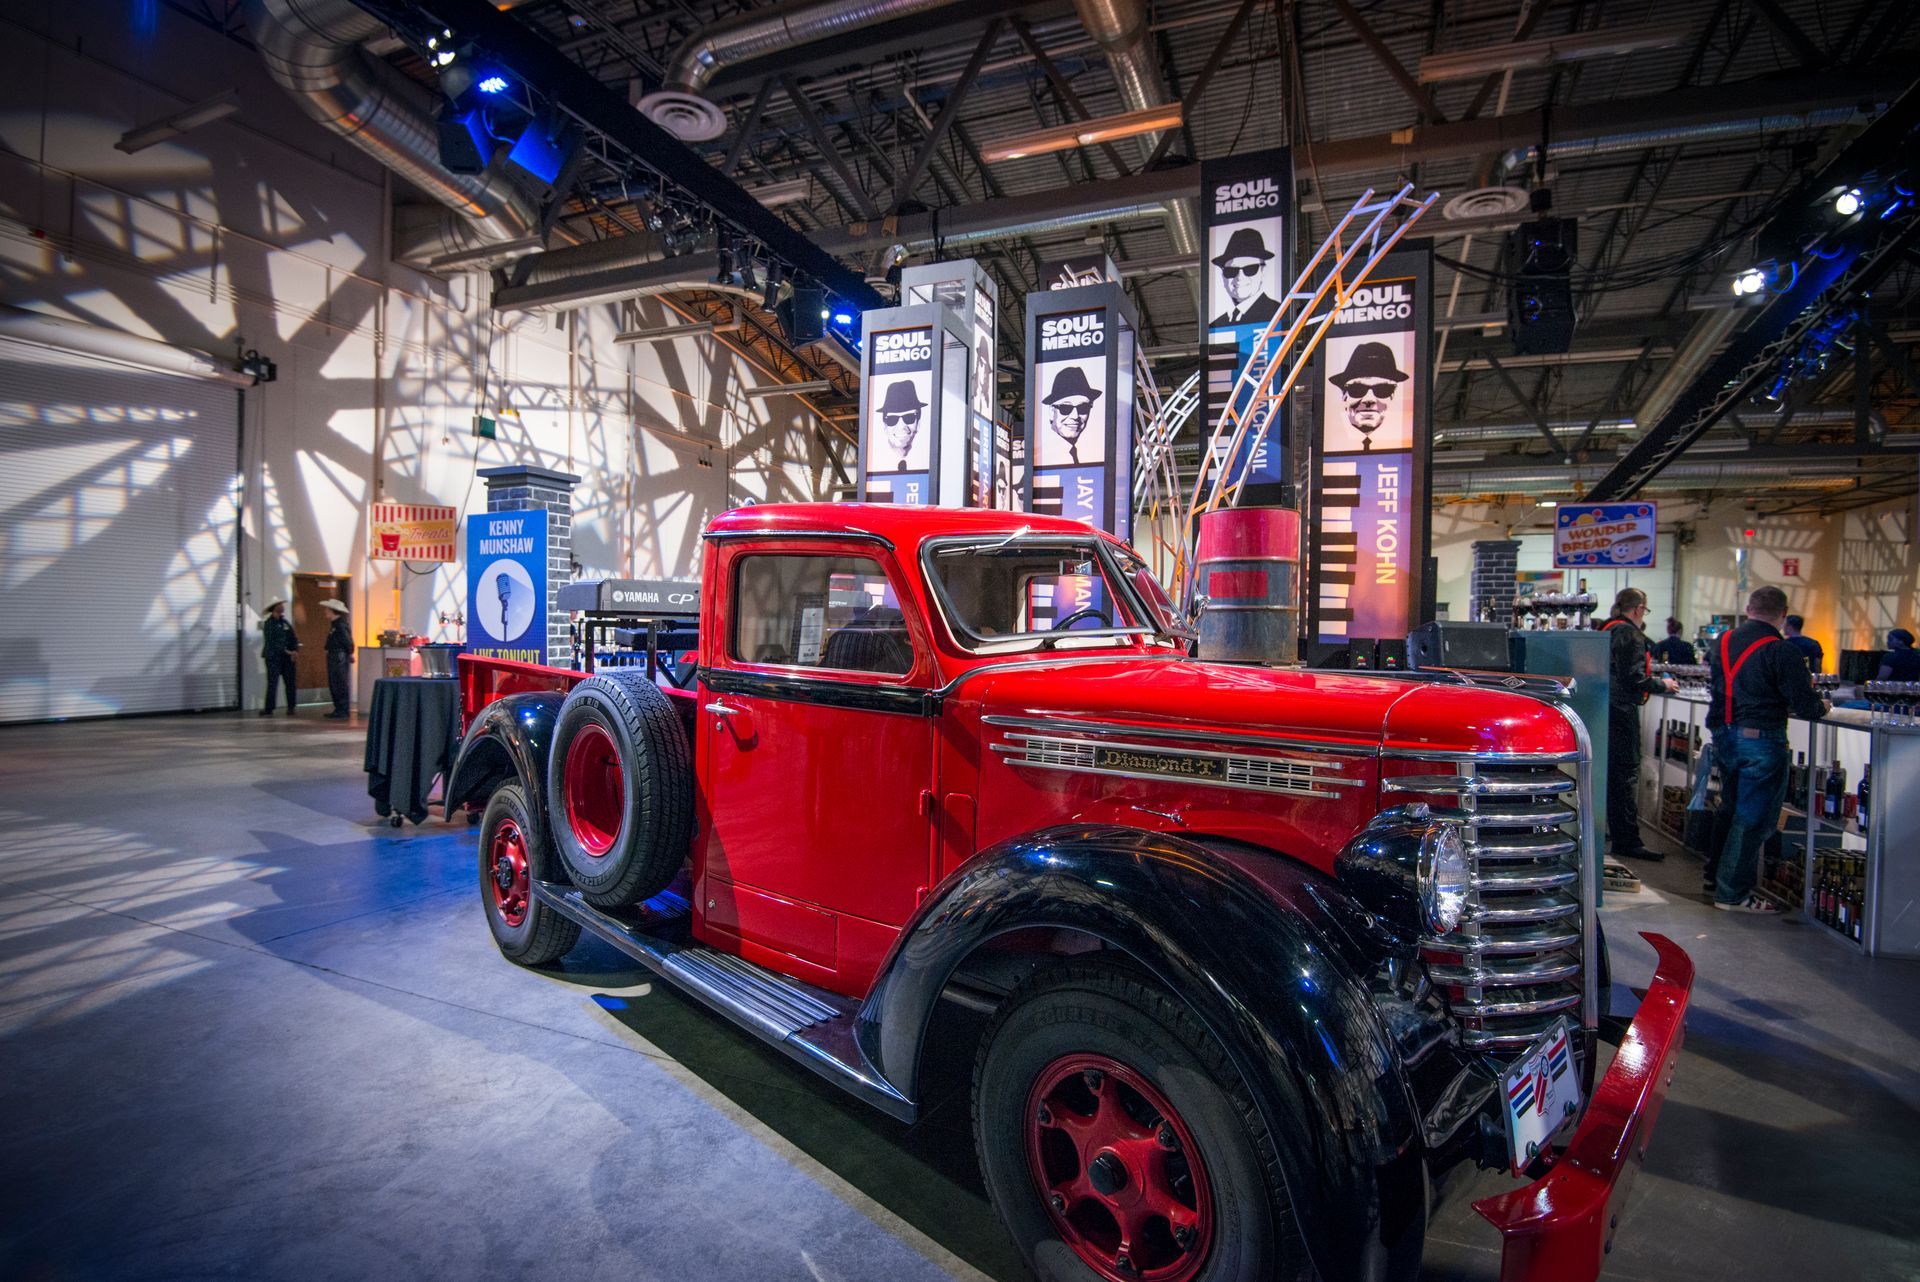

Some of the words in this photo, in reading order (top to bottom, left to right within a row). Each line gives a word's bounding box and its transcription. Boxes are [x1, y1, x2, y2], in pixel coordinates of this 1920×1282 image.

[1215, 178, 1279, 202] SOUL
[1215, 193, 1279, 215] MEN60
[1041, 314, 1104, 337] SOUL
[875, 331, 931, 351] SOUL
[1041, 330, 1104, 351] MEN60
[875, 346, 931, 364] MEN60
[1077, 476, 1094, 510] JAY
[1377, 463, 1399, 513] JEFF
[410, 527, 449, 540] Treats
[489, 519, 524, 536] KENNY
[1568, 522, 1637, 540] WONDER
[480, 537, 534, 555] MUNSHAW
[1376, 519, 1398, 584] KOHN
[1561, 538, 1612, 553] BREAD
[624, 591, 659, 603] YAMAHA
[667, 593, 694, 605] CP
[1104, 749, 1195, 774] Diamond
[1196, 759, 1217, 776] T
